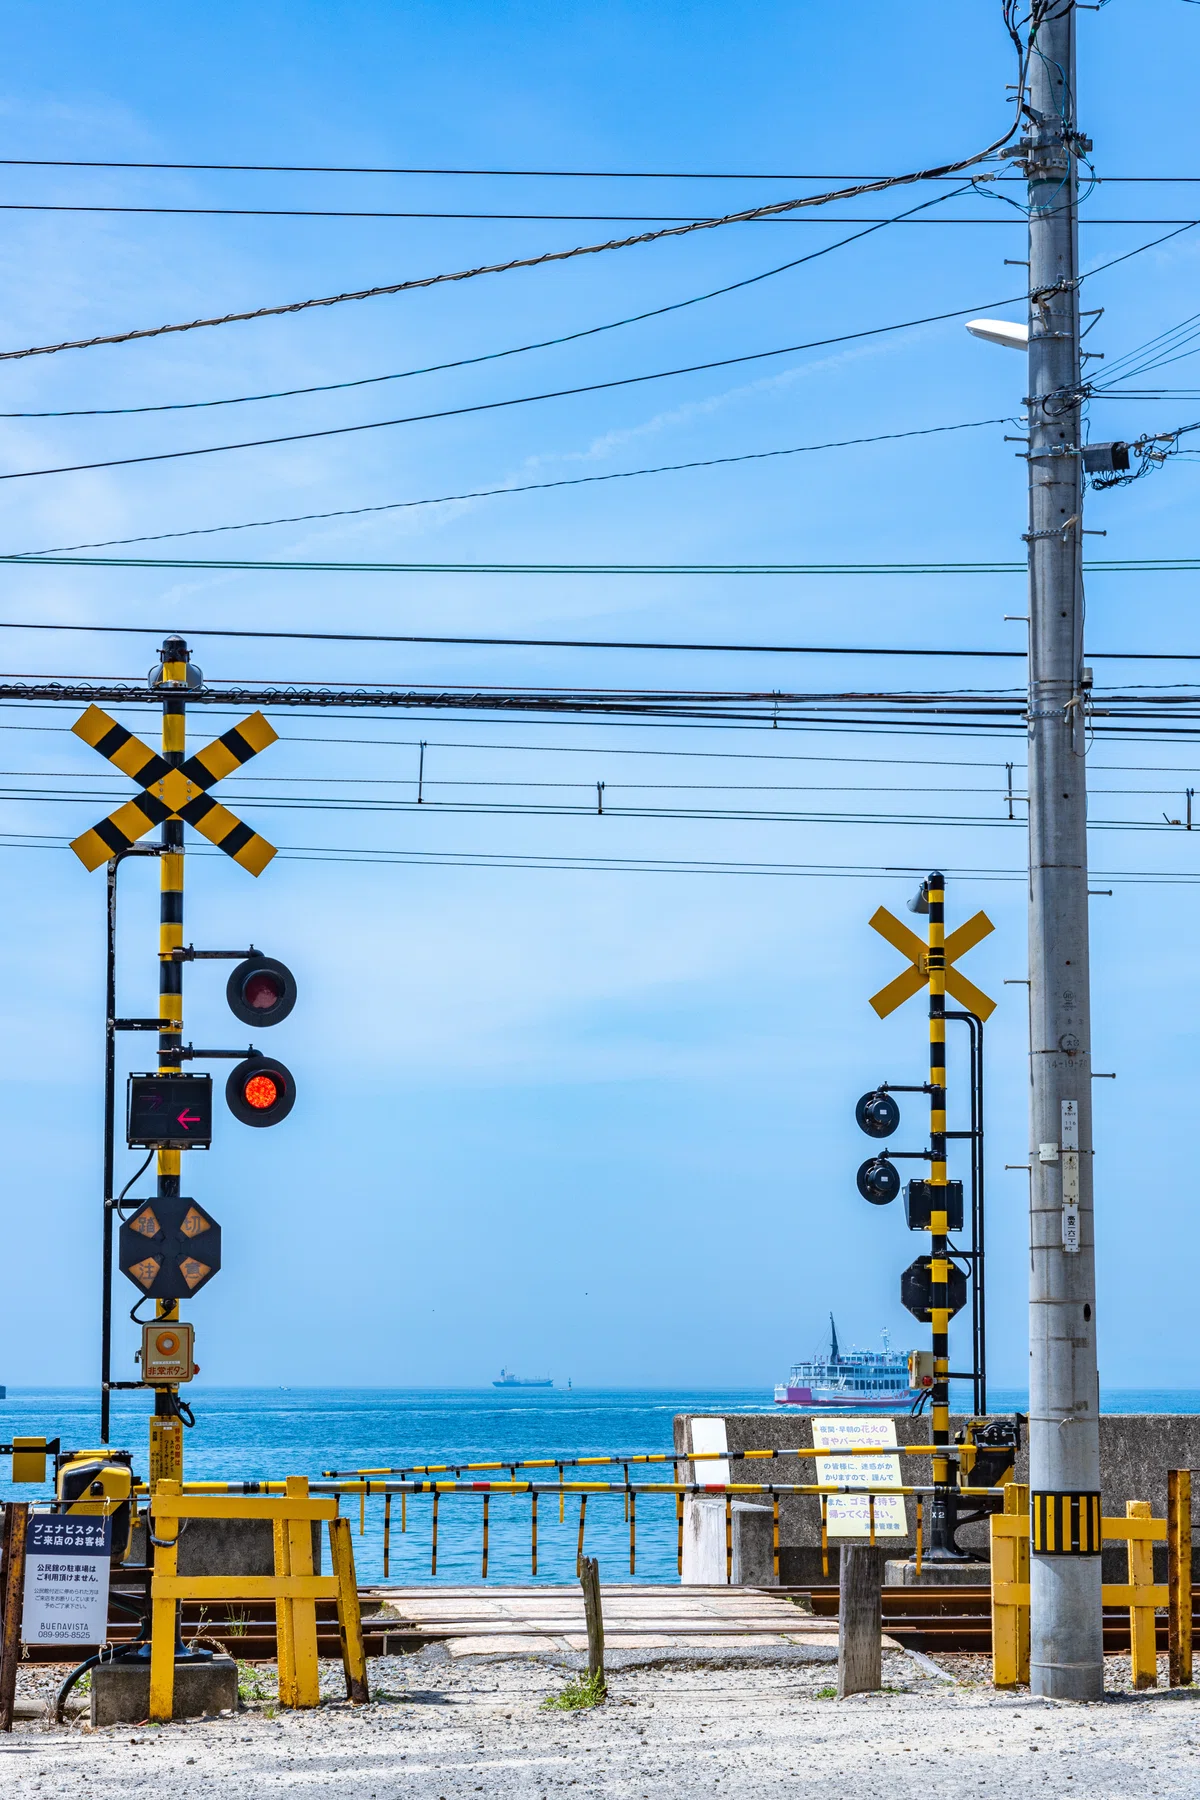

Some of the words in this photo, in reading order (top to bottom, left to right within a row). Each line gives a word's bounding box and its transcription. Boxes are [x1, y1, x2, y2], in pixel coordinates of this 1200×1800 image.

[184, 1215, 202, 1233] 切
[139, 1262, 156, 1281] 注
[148, 1366, 187, 1376] 非常ボタン
[34, 1524, 105, 1535] ブエナビスタへ
[33, 1535, 105, 1547] ご来店のお客様
[37, 1564, 96, 1573] 公民館の駐車場は
[36, 1573, 99, 1582] ご利用頂けません。
[40, 1622, 89, 1631] BUENAVISTA
[38, 1631, 91, 1639] 089-995-8525
